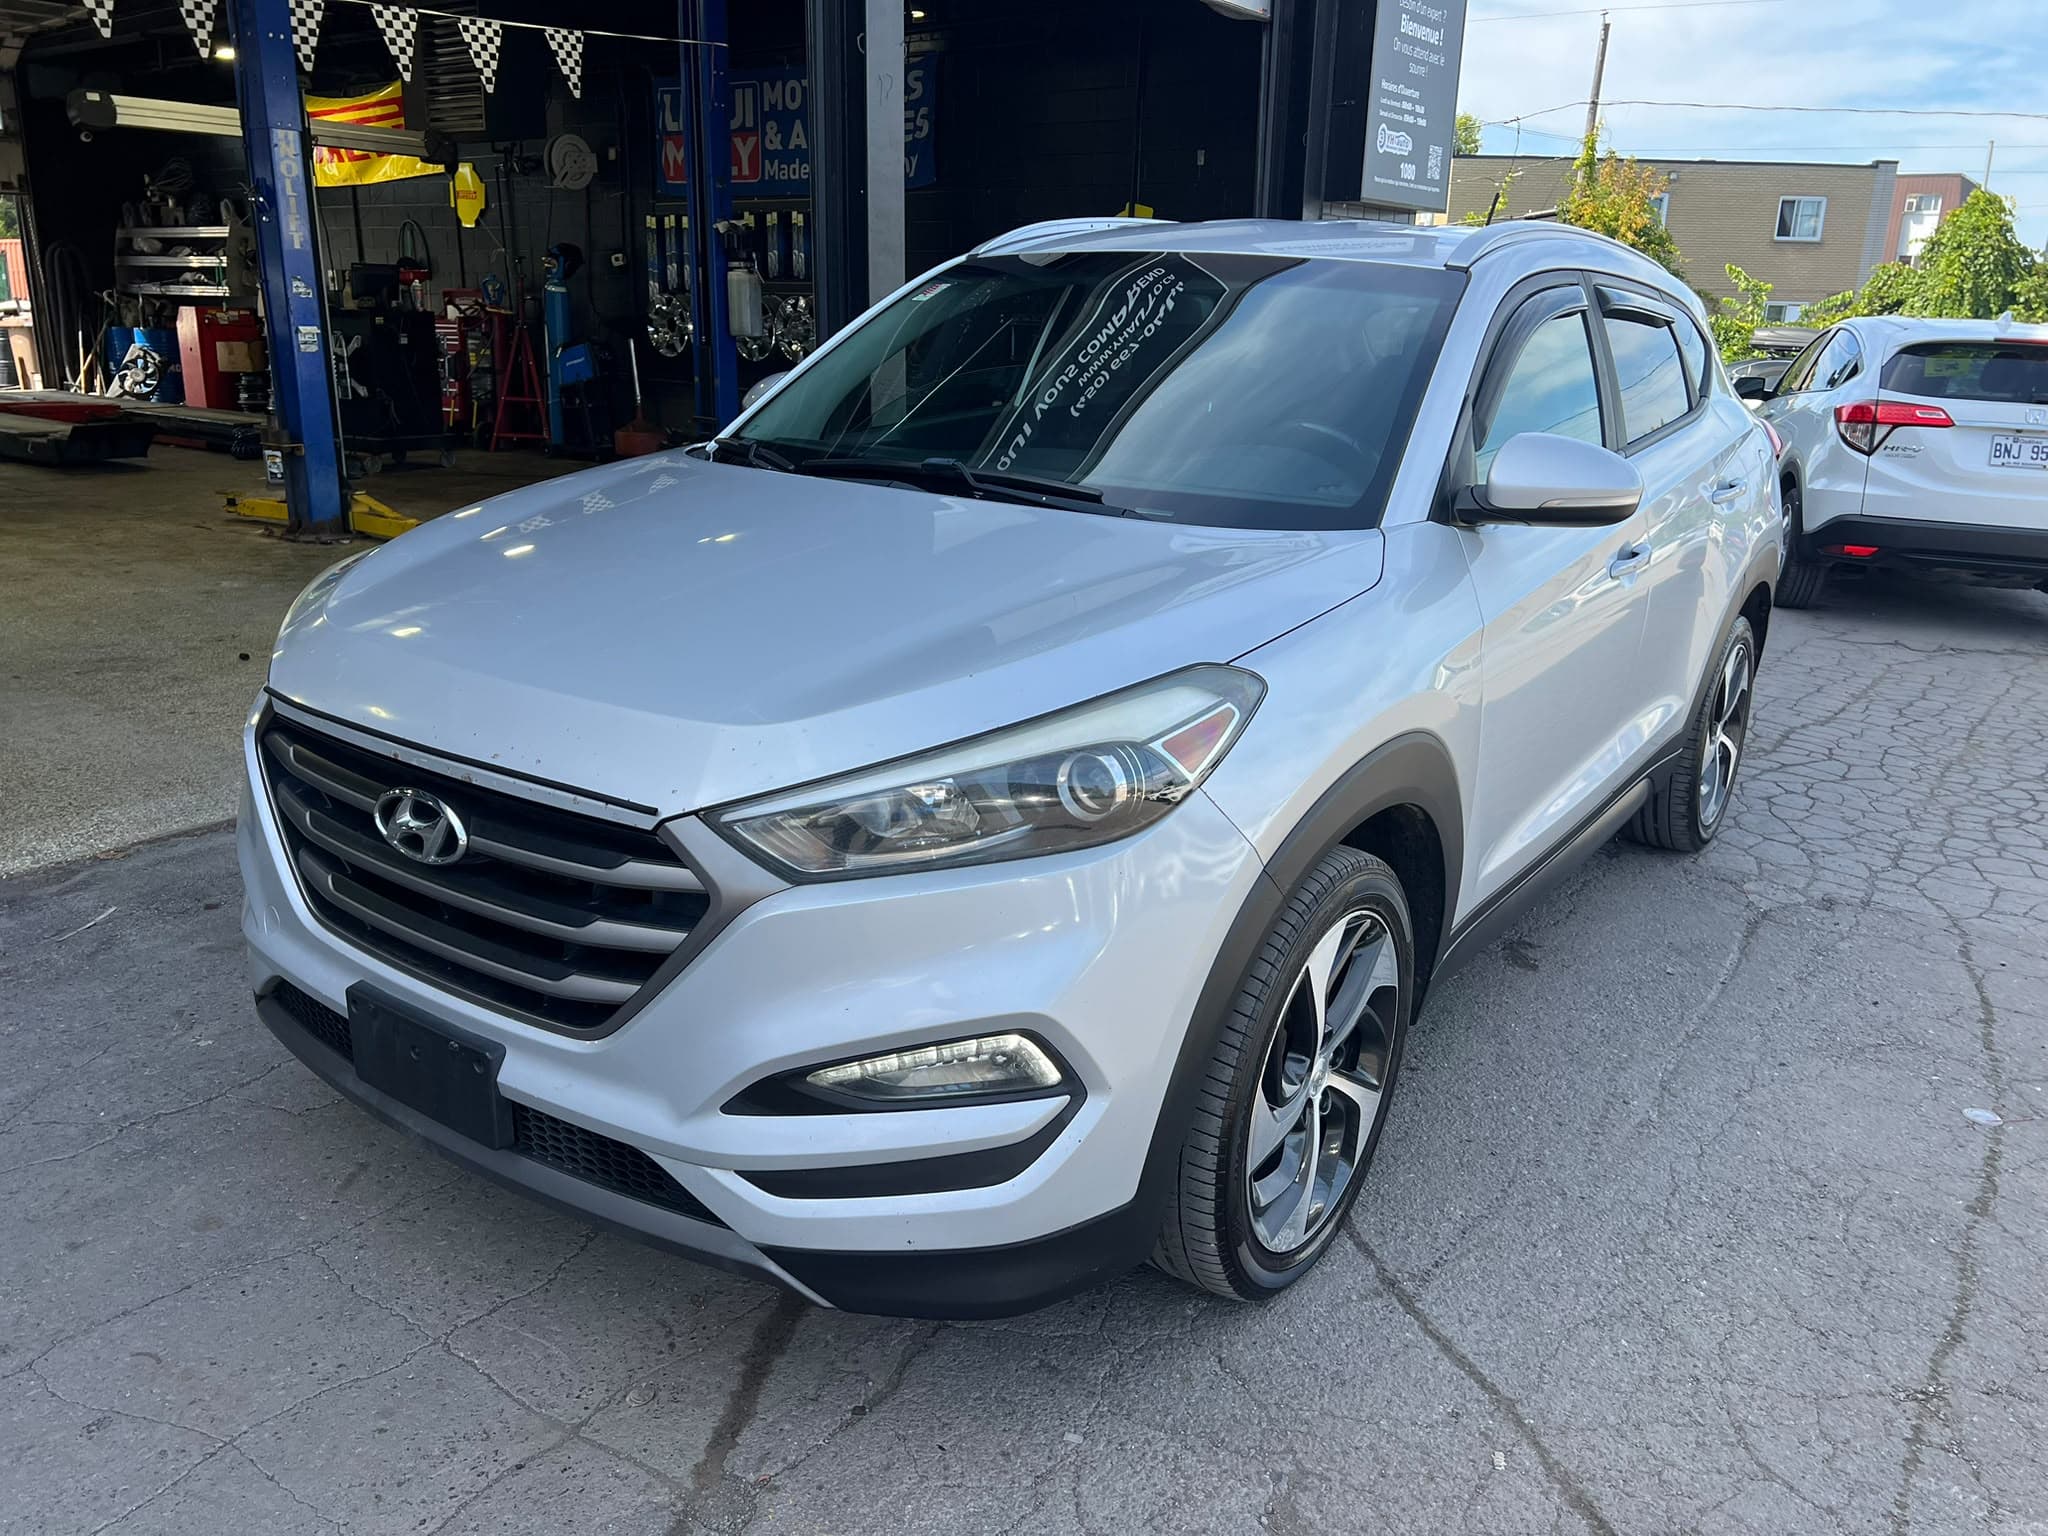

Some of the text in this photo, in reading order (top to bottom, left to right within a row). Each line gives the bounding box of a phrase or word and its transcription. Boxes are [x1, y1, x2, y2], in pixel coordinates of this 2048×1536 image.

[765, 158, 809, 180] Made
[1993, 442, 2048, 461] BNJ 95
